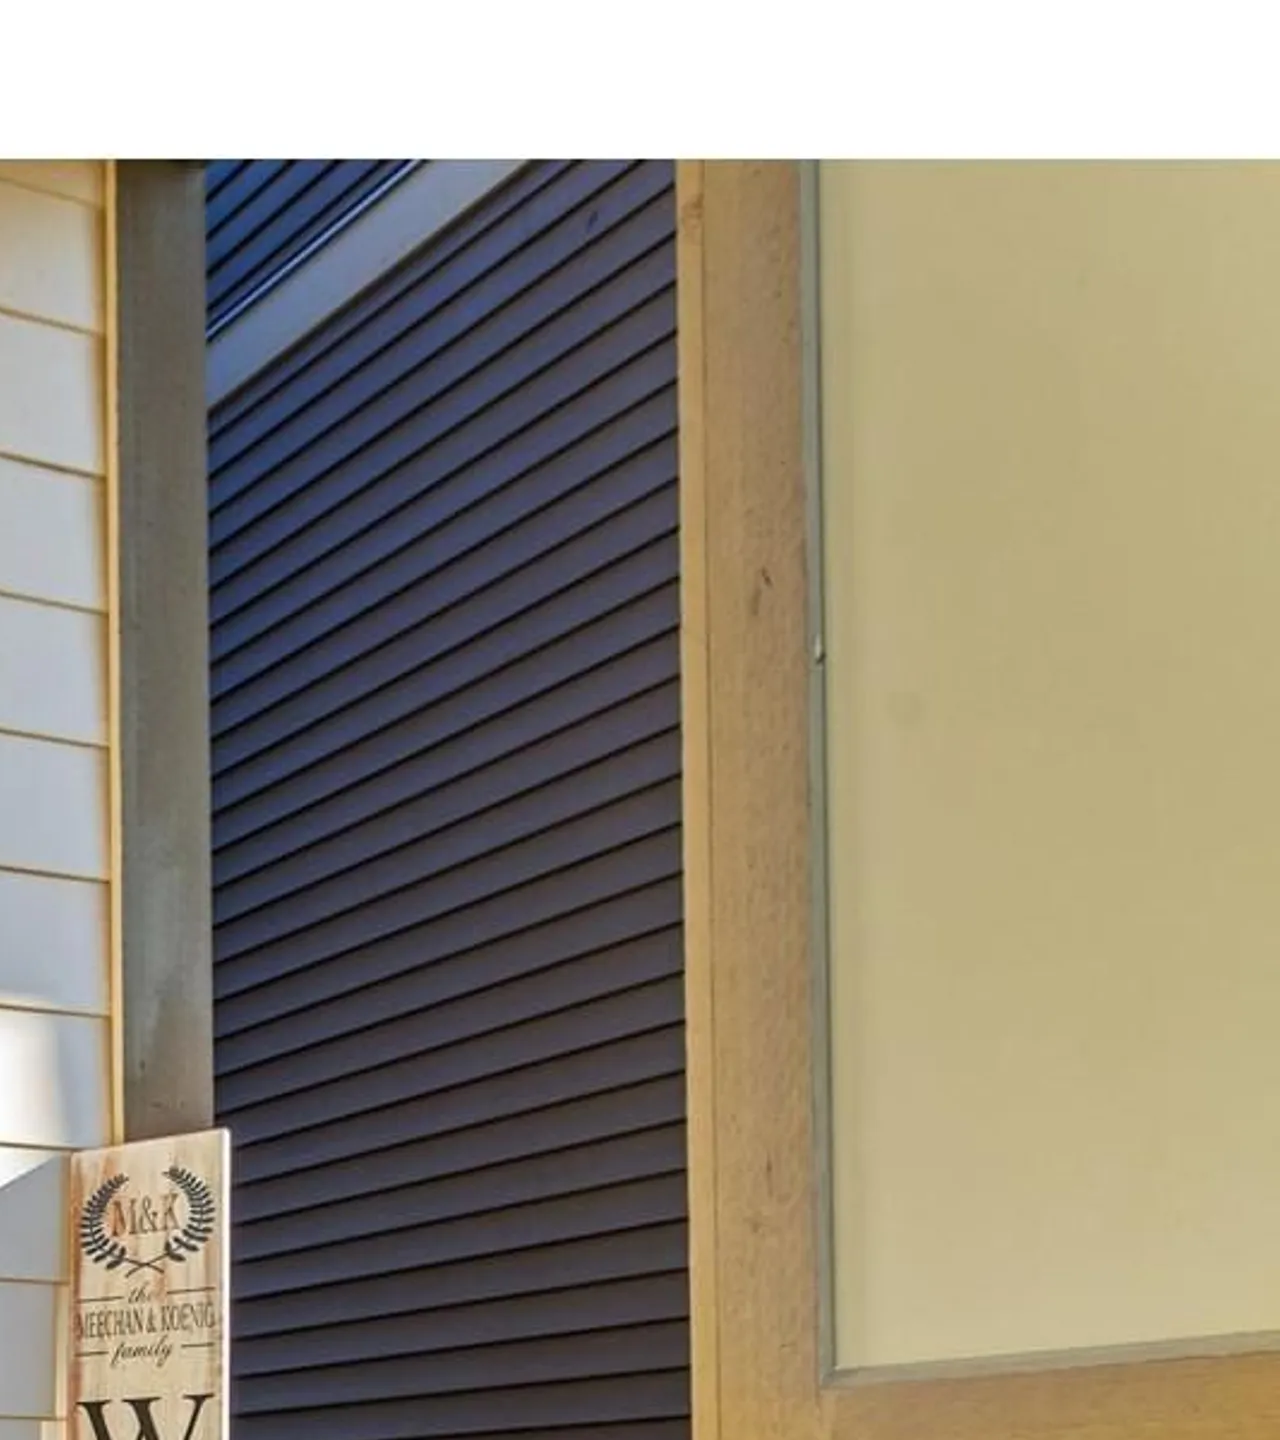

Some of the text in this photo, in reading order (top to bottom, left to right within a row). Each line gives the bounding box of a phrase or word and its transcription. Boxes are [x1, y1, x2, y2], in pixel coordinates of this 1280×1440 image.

[112, 1193, 180, 1237] M&K
[74, 1307, 144, 1340] MEECHAN
[145, 1306, 157, 1333] &
[110, 1334, 173, 1368] family
